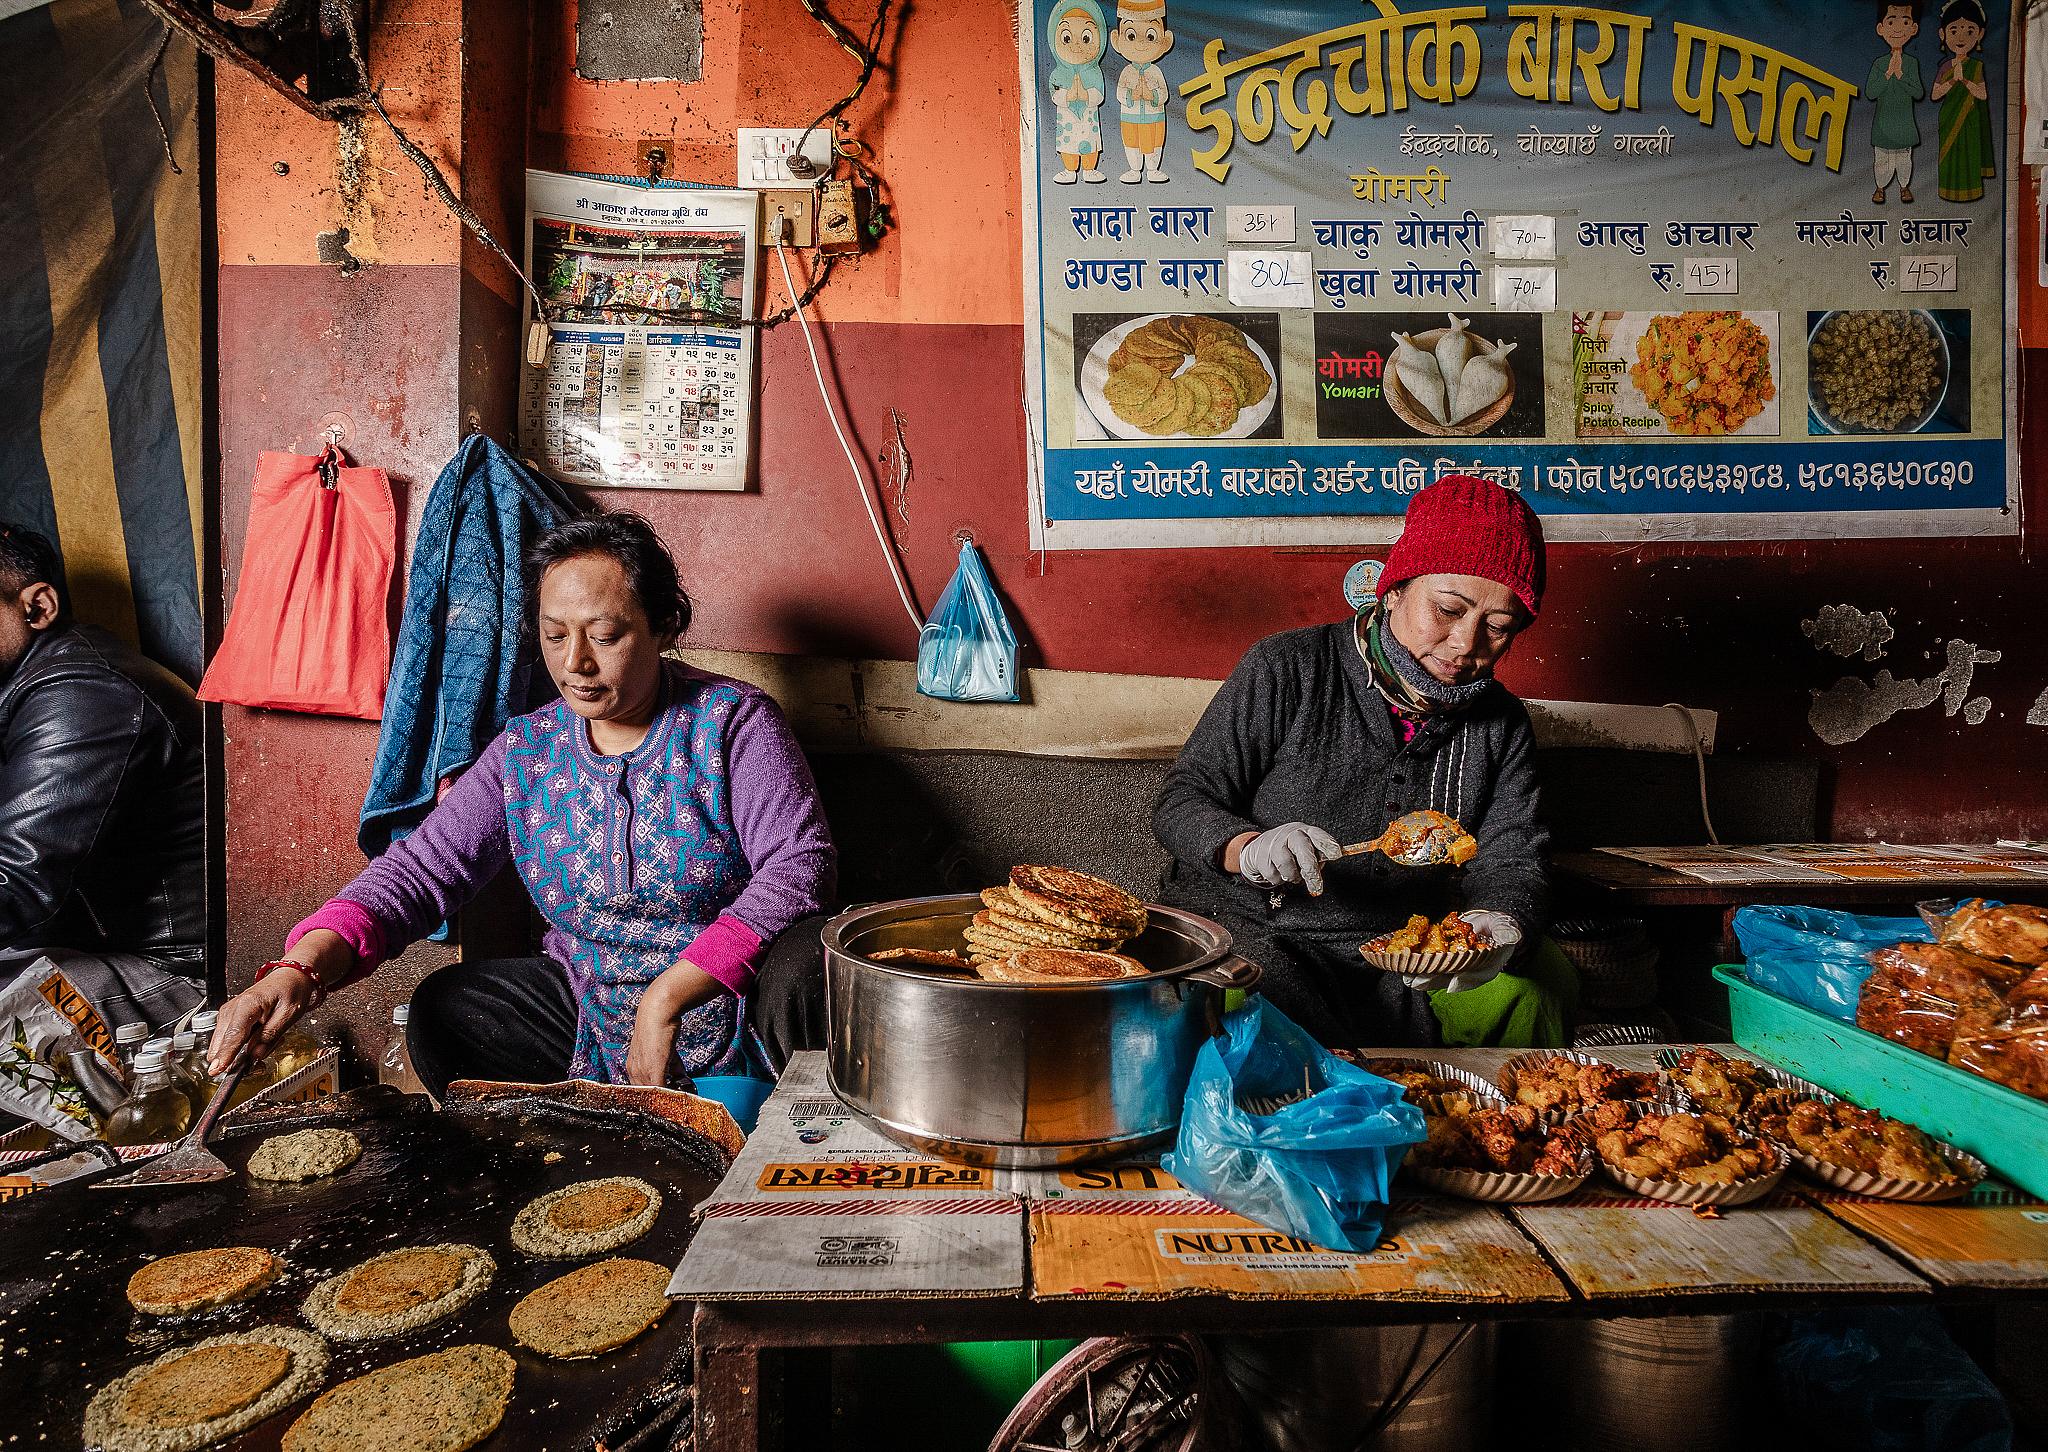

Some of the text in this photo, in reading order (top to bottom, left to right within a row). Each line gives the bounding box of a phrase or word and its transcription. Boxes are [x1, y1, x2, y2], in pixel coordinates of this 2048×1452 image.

[1178, 0, 1858, 183] ईन्द्रचोक बारा पसल
[1614, 126, 1675, 156] गल्ली
[1351, 165, 1451, 208] योमरी
[576, 198, 589, 208] श्री
[592, 202, 626, 215] आकाश
[1070, 206, 1215, 243] सादा बारा
[1311, 210, 1486, 260] चाकु योमरी
[1576, 220, 1760, 255] आलु अचार
[1794, 209, 1973, 249] मस्यौरा अचार
[1064, 259, 1225, 295] अण्डा बारा
[1316, 259, 1483, 309] खुवा योमरी
[1649, 261, 1682, 293] रु.
[1869, 260, 1895, 291] रु.
[686, 350, 698, 359] १२
[1581, 337, 1608, 354] पिरो
[705, 370, 717, 378] २०
[1317, 351, 1384, 379] योमरी
[1582, 357, 1628, 380] आलुको
[1321, 382, 1380, 400] Yomari
[1582, 381, 1619, 395] अचार
[1583, 402, 1614, 414] Spicy
[1583, 416, 1660, 429] Potato Recipe
[1074, 460, 1126, 499] यहाँ
[1131, 460, 1213, 498] योमरी,
[1221, 459, 1308, 498] बाराको
[1312, 461, 1375, 495] अर्डर
[1380, 458, 1428, 495] पनि
[1547, 457, 1607, 494] फोन
[1265, 1254, 1368, 1263] SUNFLOWER
